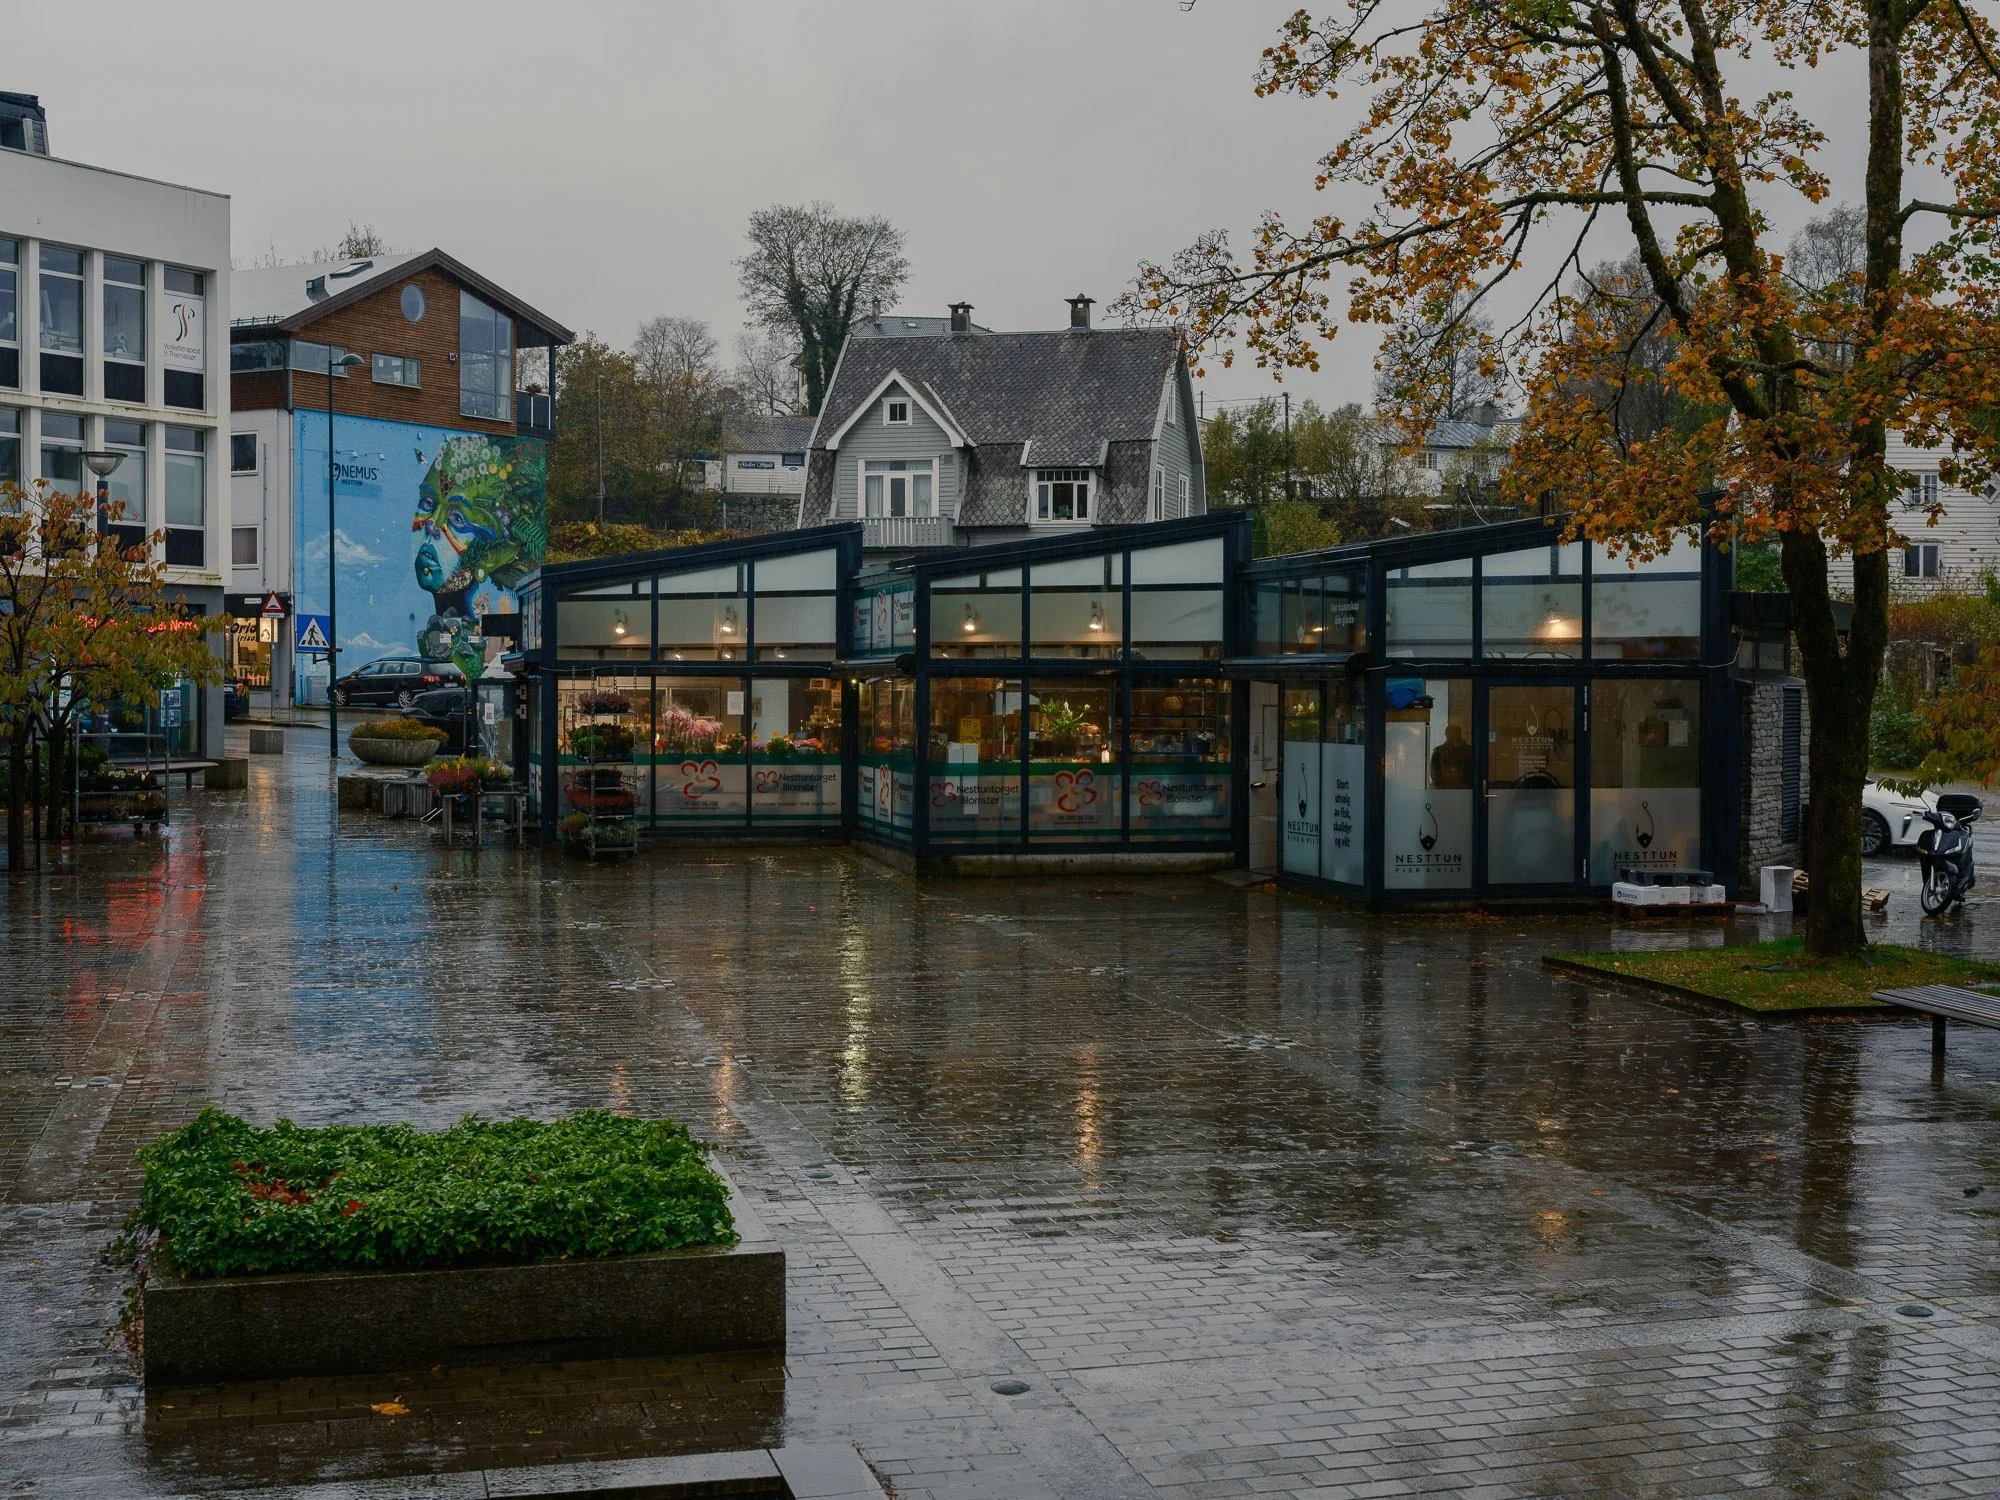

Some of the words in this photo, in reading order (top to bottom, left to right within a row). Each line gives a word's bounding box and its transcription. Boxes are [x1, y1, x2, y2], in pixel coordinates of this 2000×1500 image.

[779, 773, 837, 783] Nesttuntorget
[782, 783, 818, 791] Blomster
[956, 785, 1019, 796] Nesttuntorget
[1162, 783, 1224, 793] Nesttuntorget
[960, 795, 999, 805] Blomster
[1166, 794, 1204, 803] Blomster
[1287, 820, 1319, 833] NESTTUN
[1395, 854, 1462, 863] NESTTUN
[1614, 851, 1677, 860] NESTTUN
